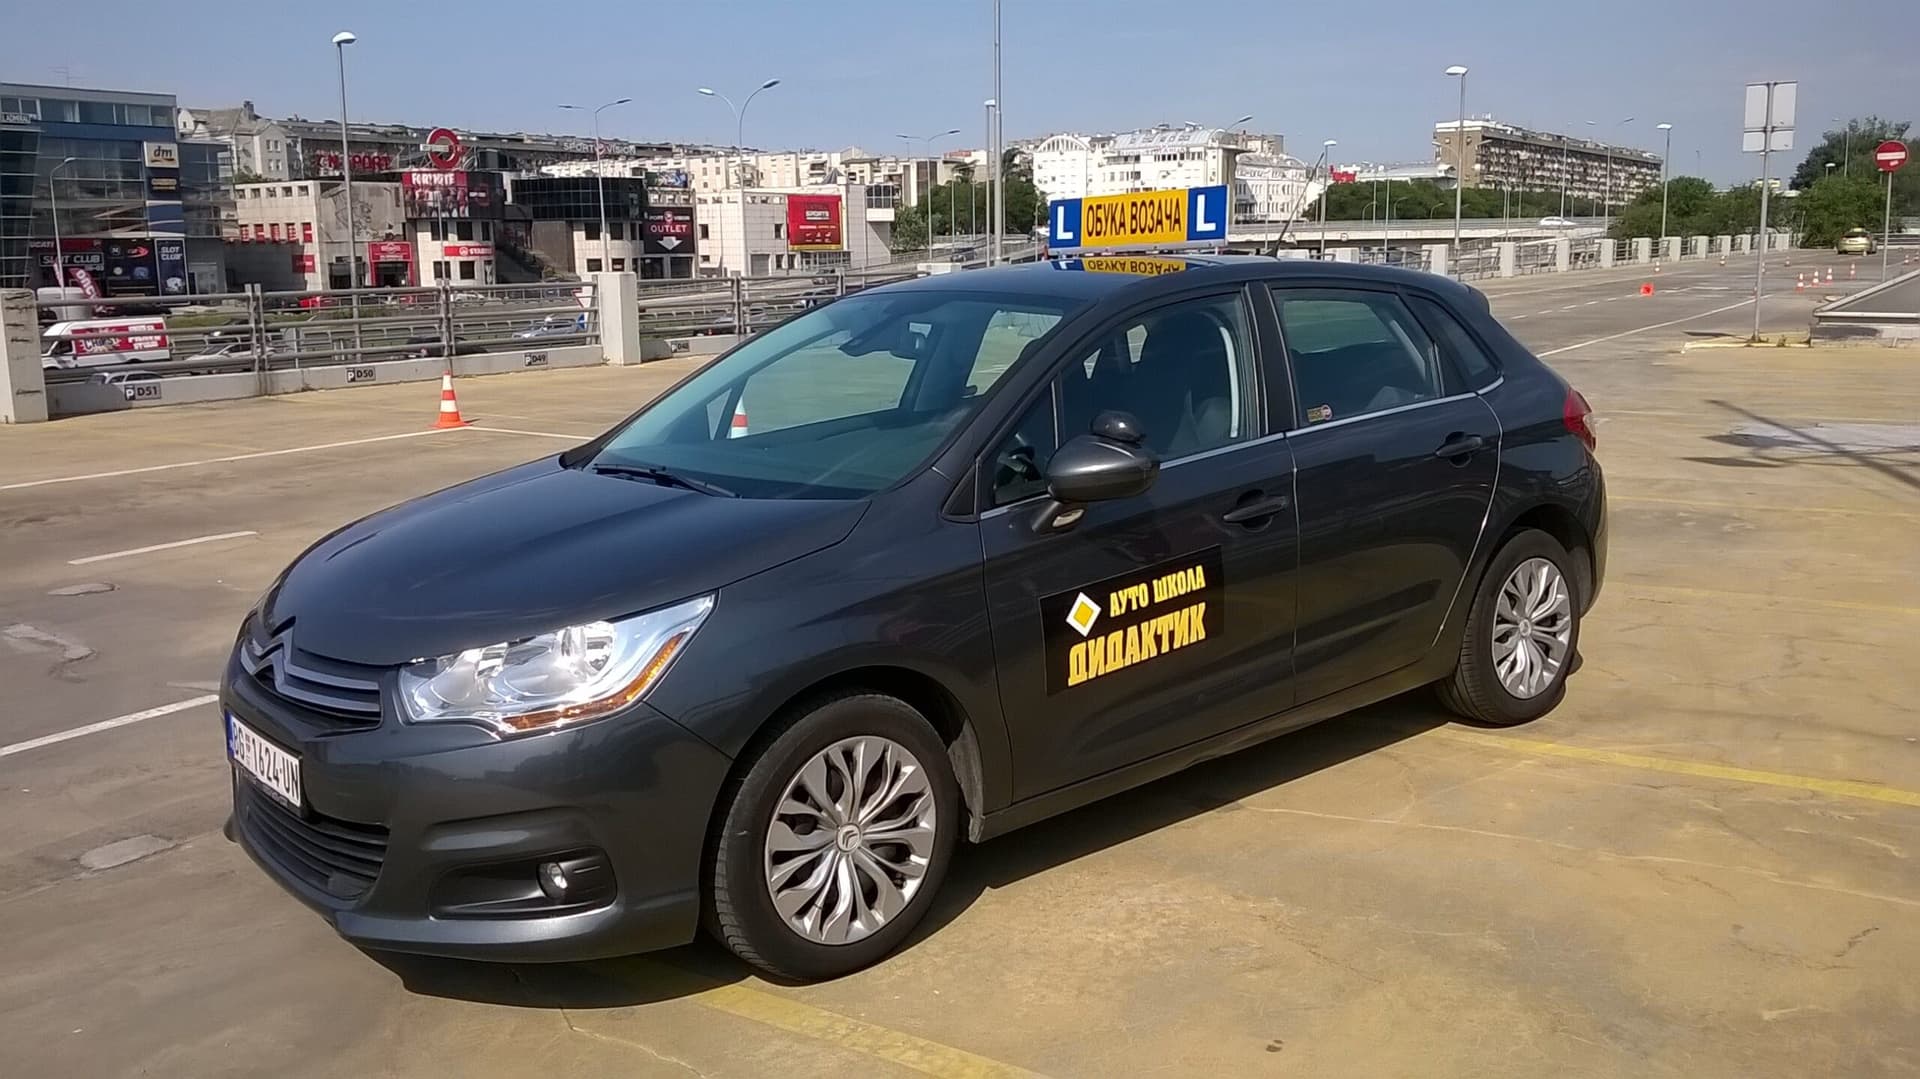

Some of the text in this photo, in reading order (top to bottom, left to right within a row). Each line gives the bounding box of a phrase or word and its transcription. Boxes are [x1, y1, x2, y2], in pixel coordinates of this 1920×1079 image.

[153, 146, 173, 157] dm
[1086, 197, 1182, 237] ОБУКА ВОЗАЧА
[1196, 194, 1217, 232] L
[650, 224, 688, 233] OUTLET
[1057, 206, 1074, 240] L
[161, 246, 180, 254] SLOT
[73, 254, 100, 263] CLUB
[356, 369, 374, 378] D50
[137, 386, 158, 396] D51
[1110, 565, 1206, 618] АУТО ШКОЛА
[1067, 602, 1206, 687] ДИДАКТИК
